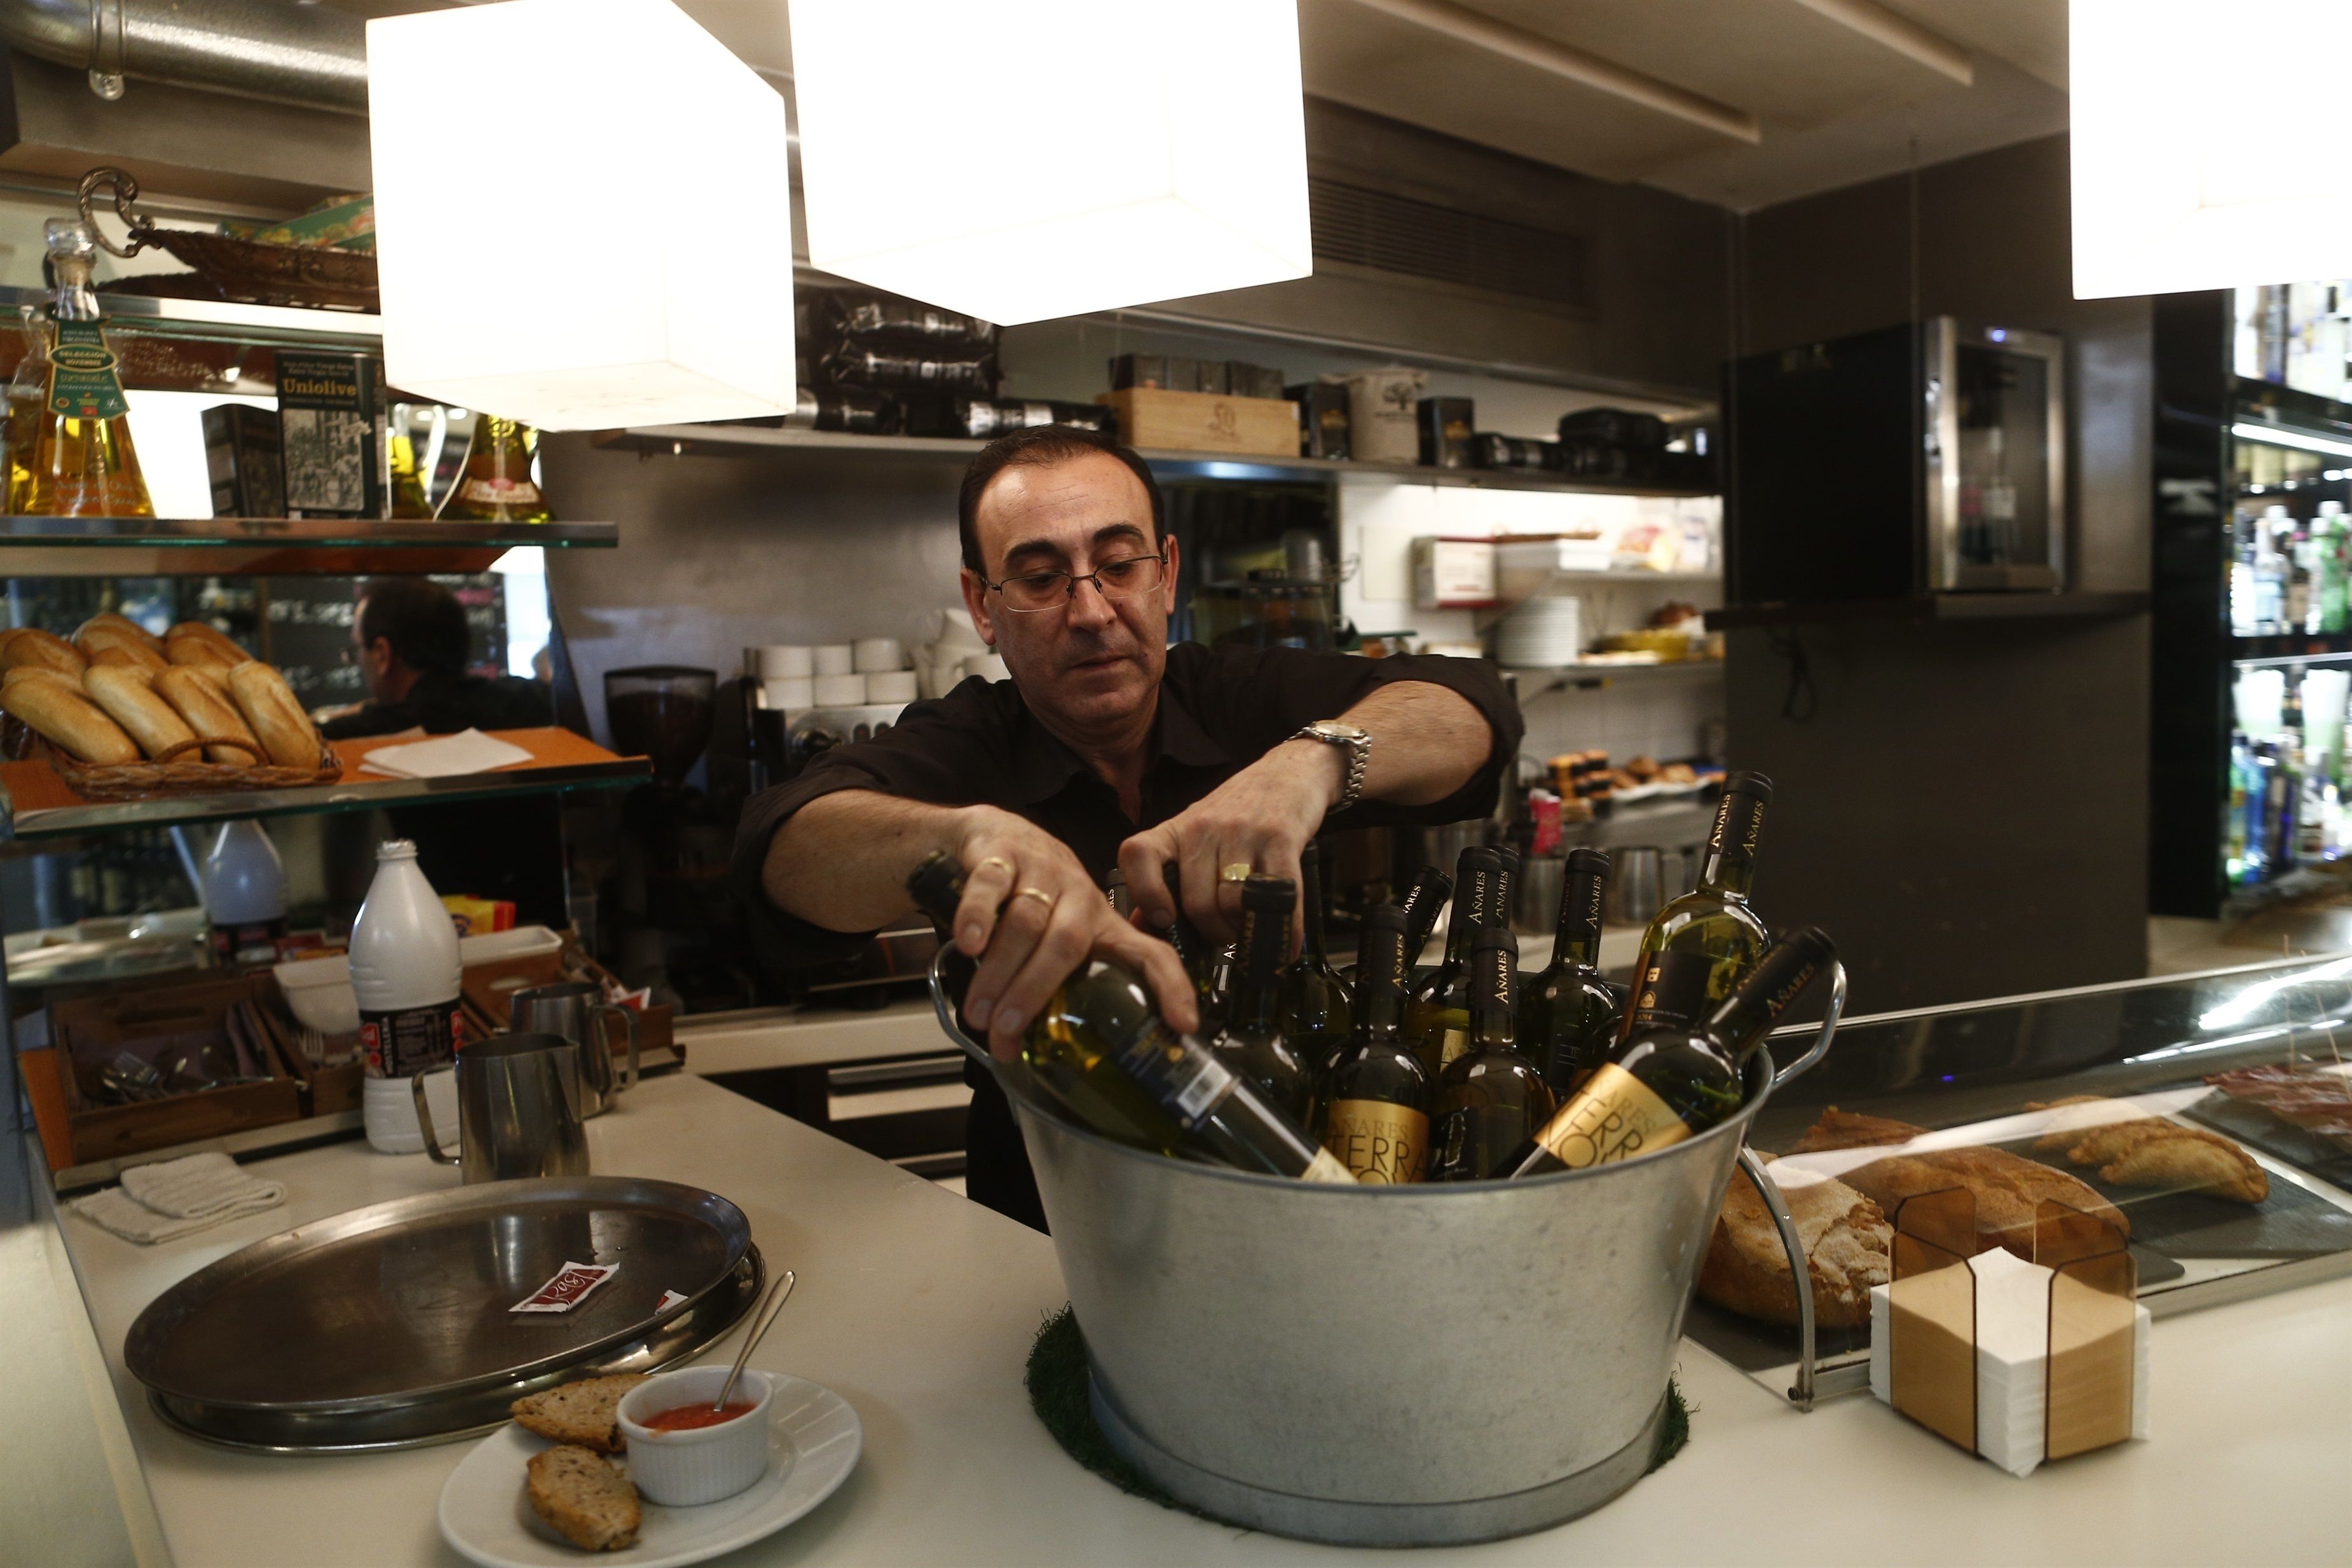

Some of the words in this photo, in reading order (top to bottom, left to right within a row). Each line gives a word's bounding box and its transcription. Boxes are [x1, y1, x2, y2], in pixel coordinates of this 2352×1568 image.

[283, 378, 357, 397] Uniolive
[1742, 800, 1764, 857] AÑARES
[1468, 871, 1486, 925] AÑARES
[1586, 875, 1602, 929] AÑARES
[1495, 949, 1509, 1004] AÑARES
[1329, 1134, 1426, 1184] TERRA
